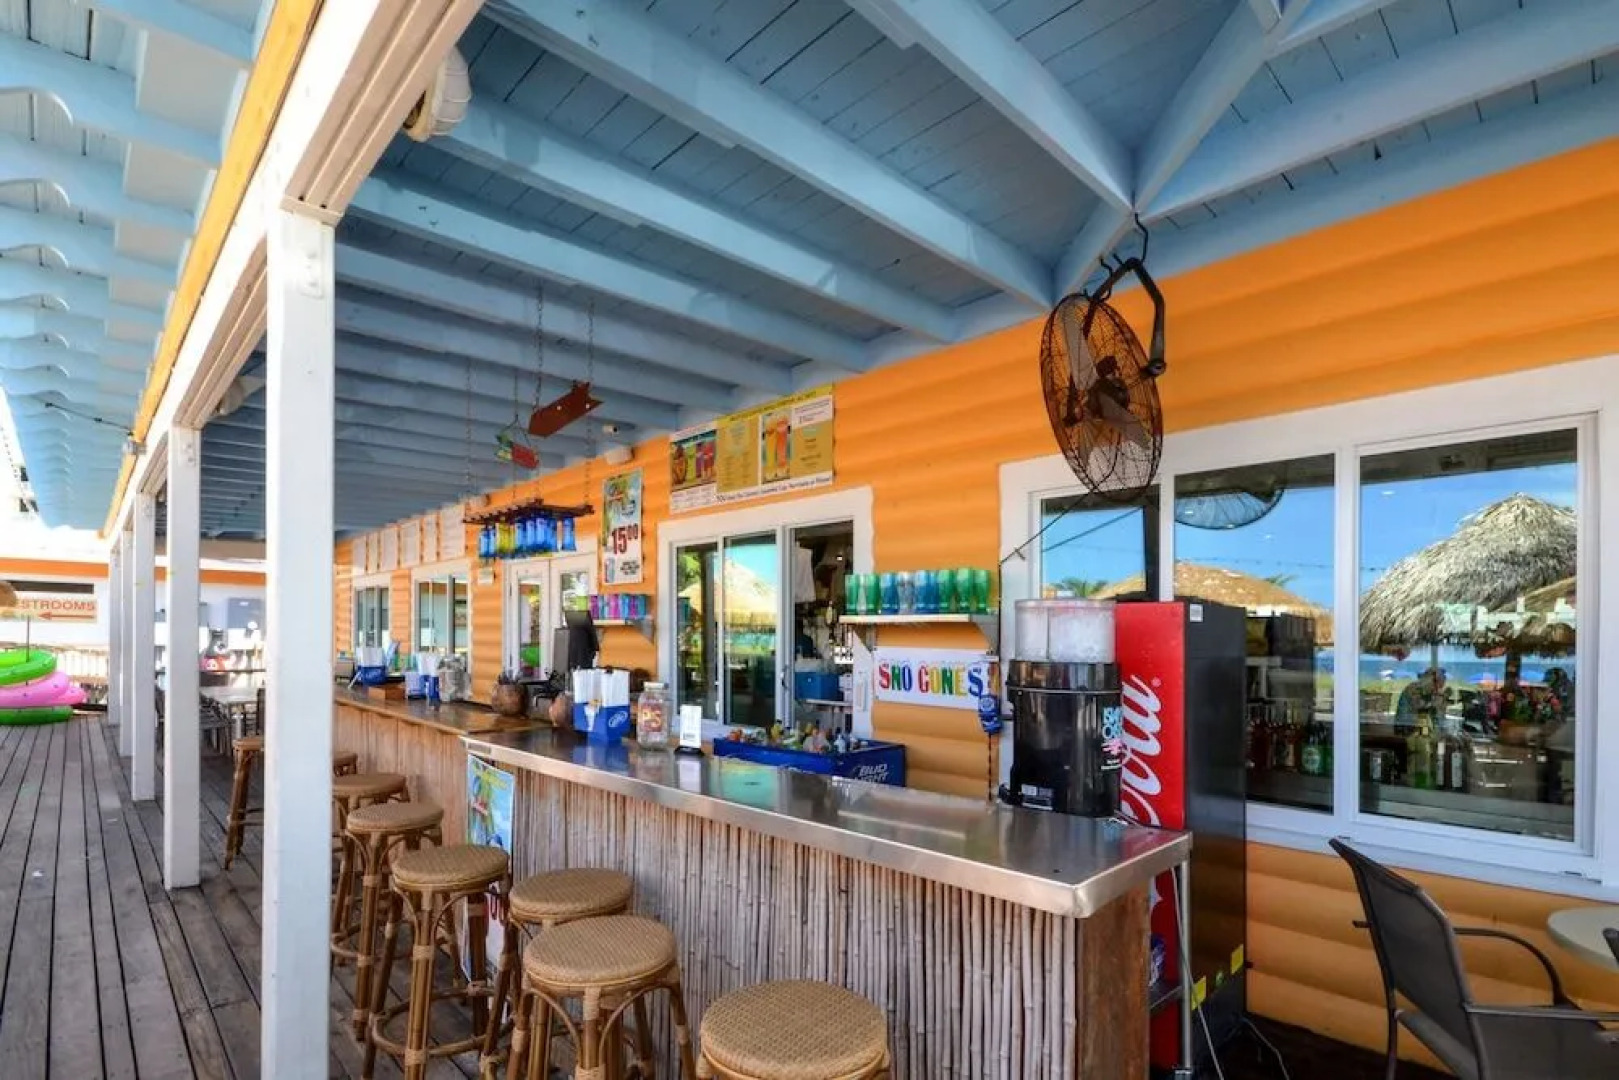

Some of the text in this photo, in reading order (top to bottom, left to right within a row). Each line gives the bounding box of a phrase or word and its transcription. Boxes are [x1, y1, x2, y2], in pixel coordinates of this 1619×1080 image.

[19, 599, 95, 611] STROOMS
[878, 662, 985, 698] SNO CONES
